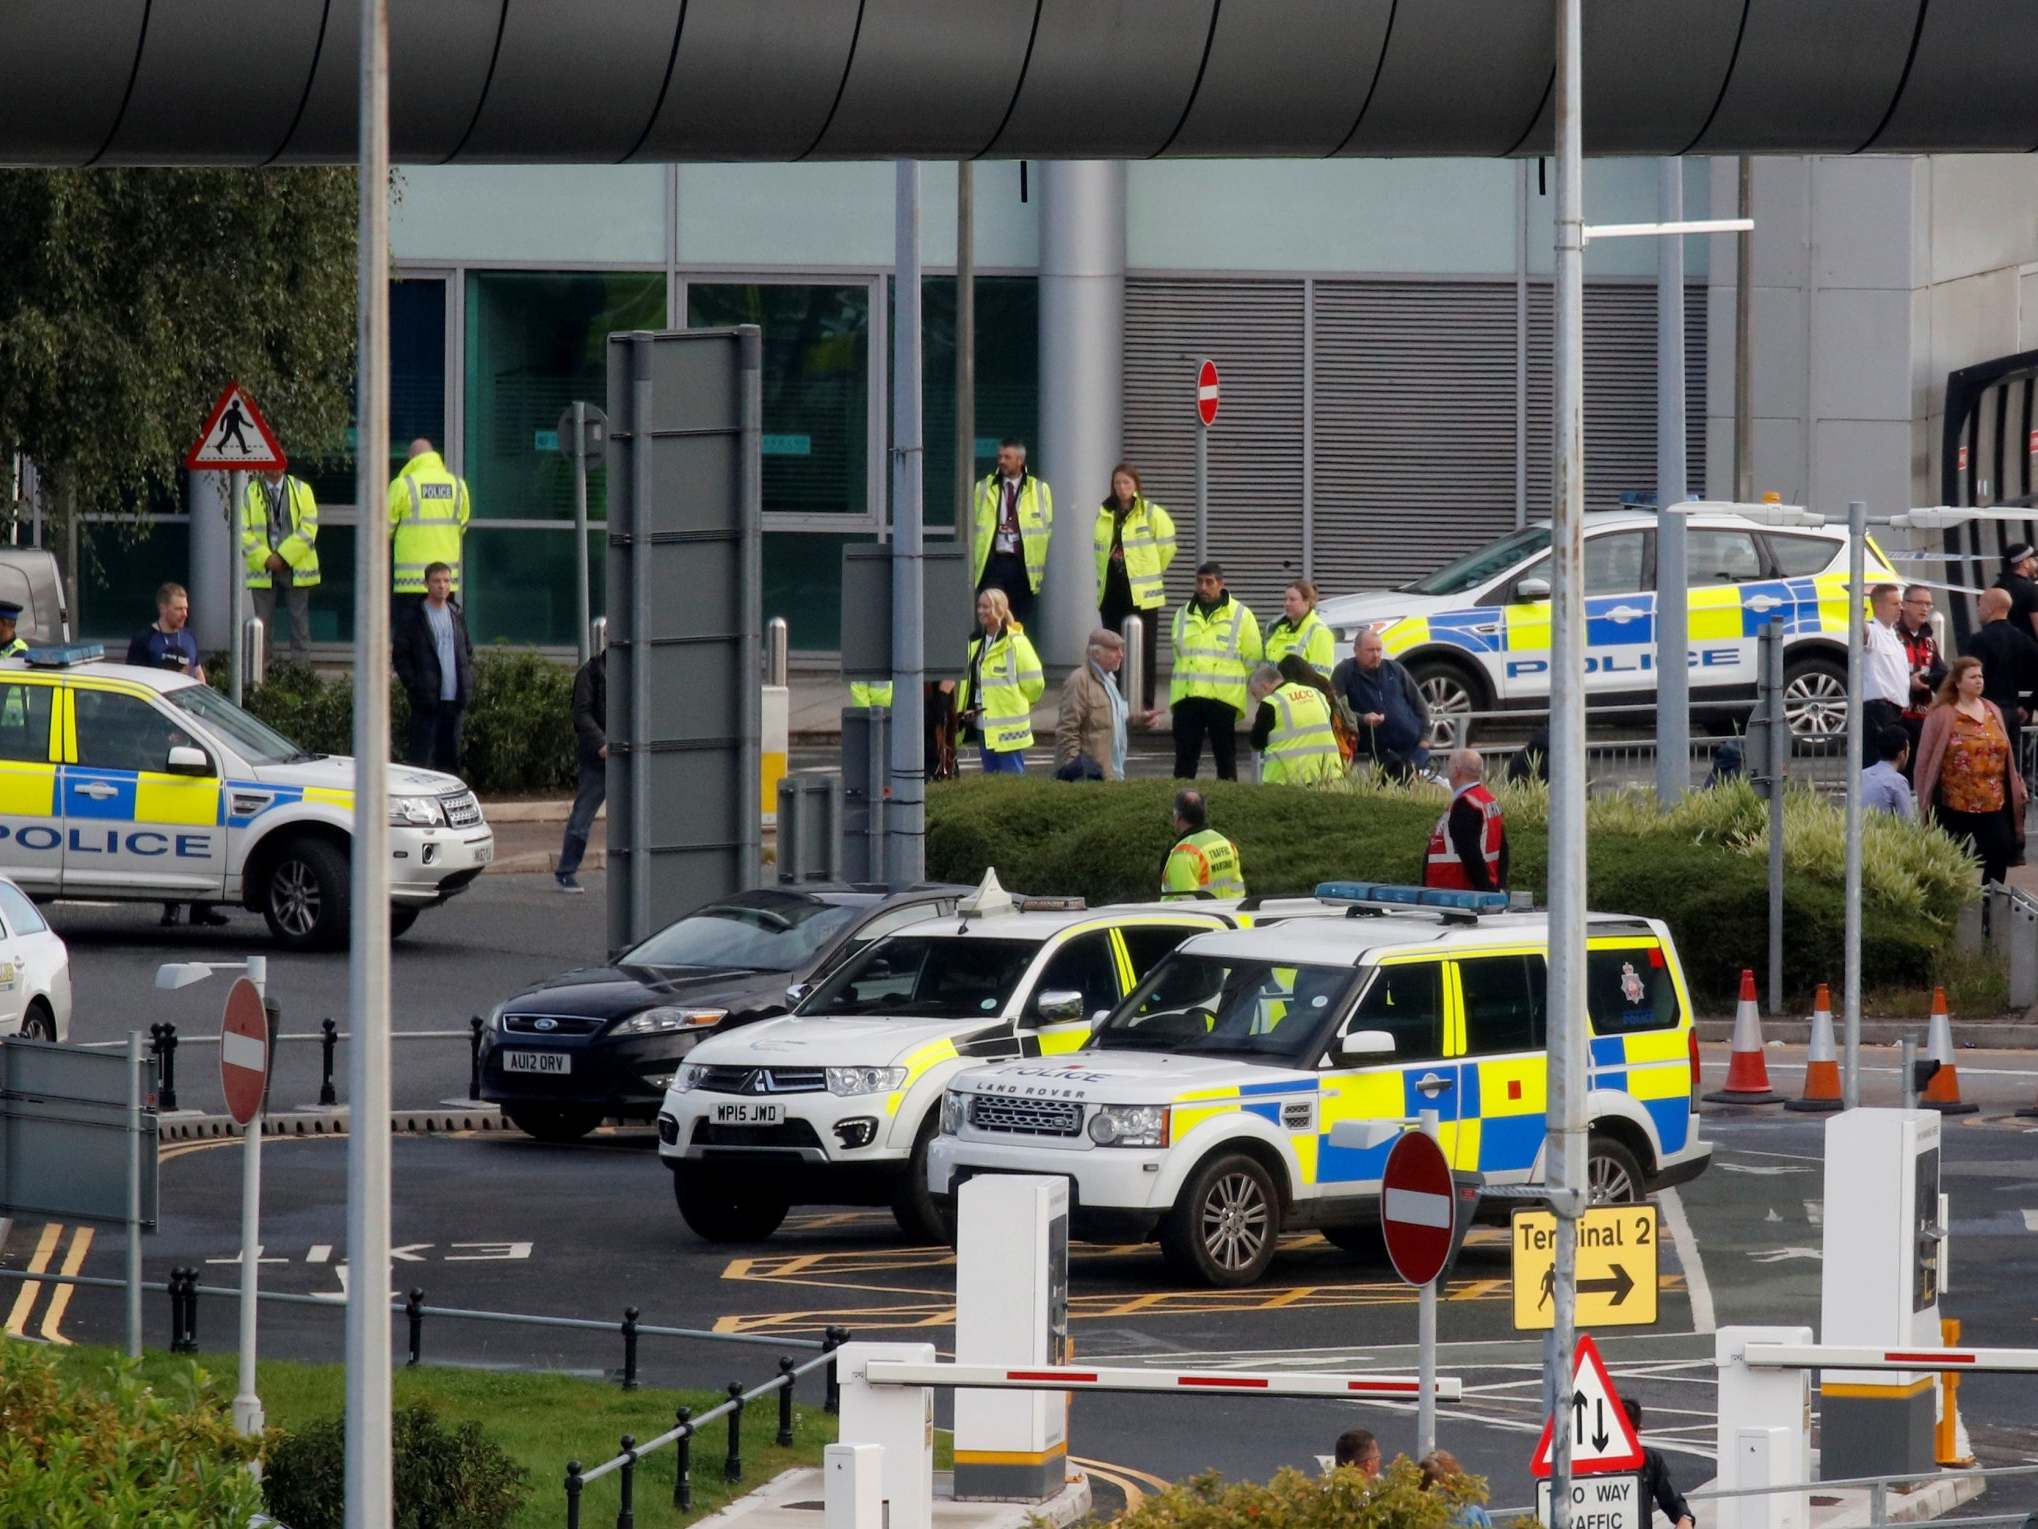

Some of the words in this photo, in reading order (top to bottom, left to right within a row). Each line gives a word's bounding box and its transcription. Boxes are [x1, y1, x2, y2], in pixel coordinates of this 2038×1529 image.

[423, 485, 451, 498] POLICE
[1506, 647, 1741, 679] PLIE
[0, 825, 212, 858] OLICE
[511, 1053, 537, 1070] AU12
[540, 1055, 563, 1071] ORV
[976, 1082, 1017, 1093] LAND
[1026, 1087, 1086, 1099] ROVER
[718, 1105, 747, 1121] WP15
[751, 1105, 776, 1121] JWD
[1519, 1219, 1623, 1250] Terinal
[1635, 1217, 1650, 1245] 2
[1596, 1484, 1631, 1503] WAY
[1569, 1512, 1623, 1529] AFFIC
